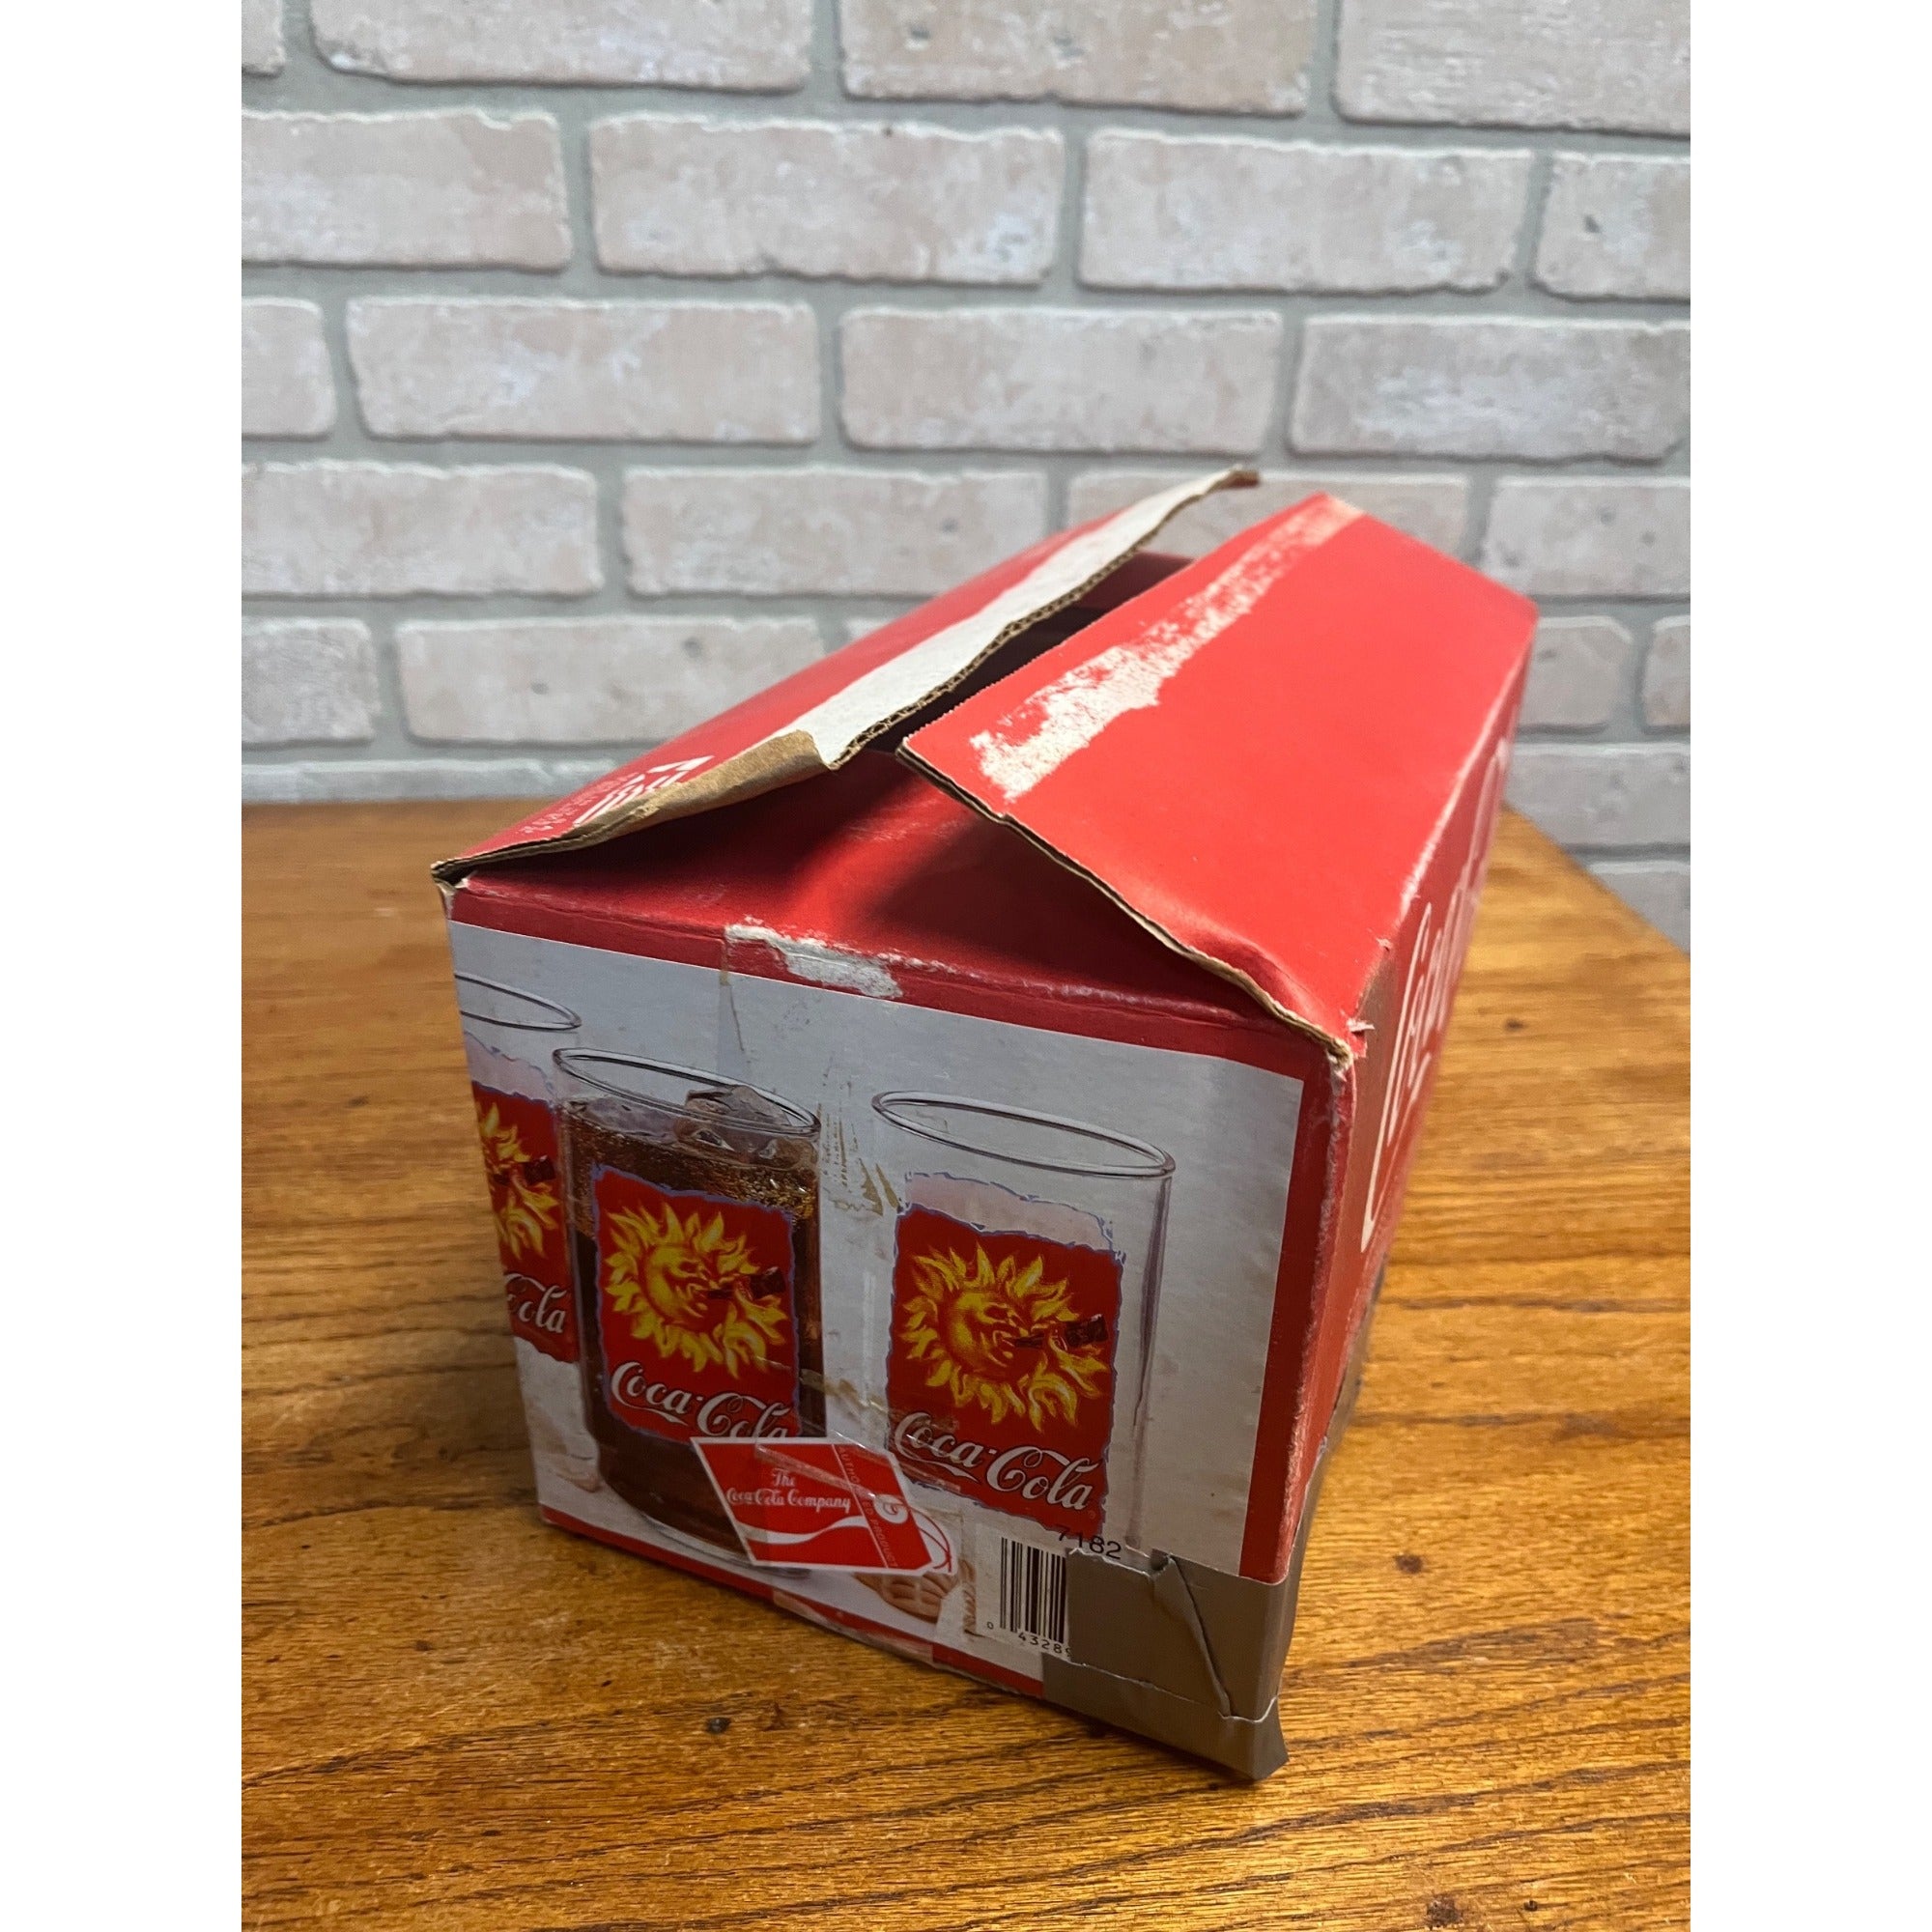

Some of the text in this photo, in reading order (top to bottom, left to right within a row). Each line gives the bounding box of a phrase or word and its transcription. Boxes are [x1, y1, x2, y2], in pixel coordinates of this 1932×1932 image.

[895, 1411, 1098, 1510] Coca-Cola
[772, 1467, 795, 1487] The
[787, 1489, 851, 1514] Company
[1058, 1523, 1121, 1559] 7182
